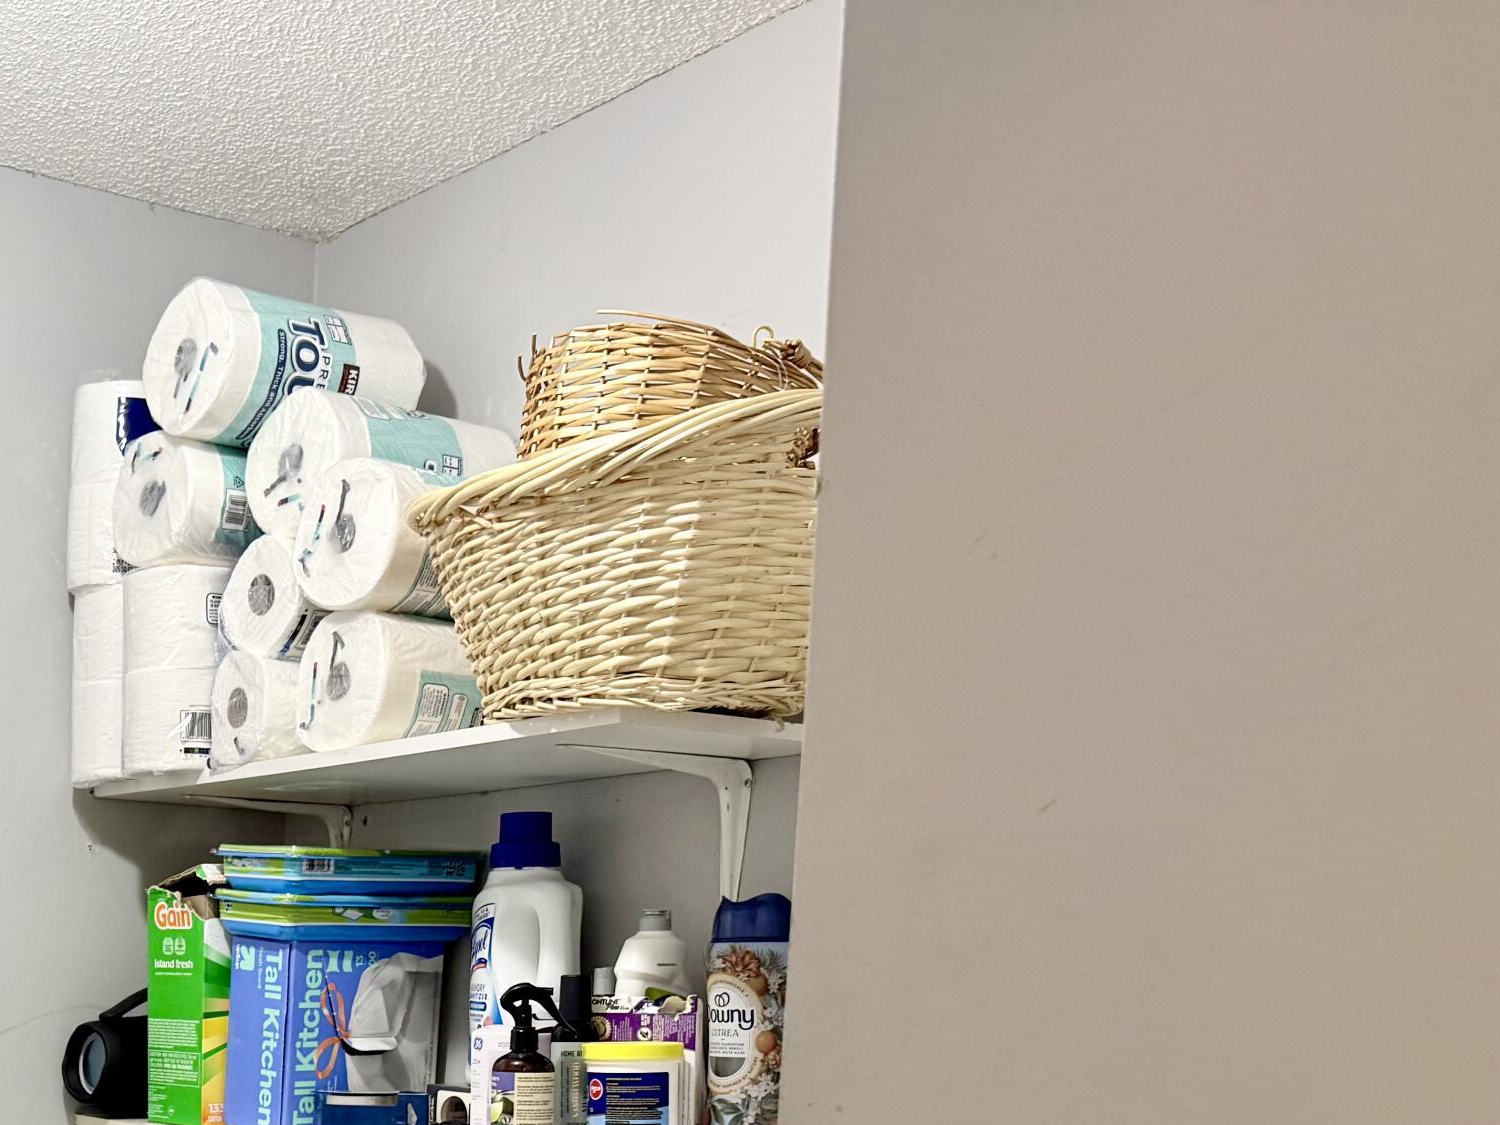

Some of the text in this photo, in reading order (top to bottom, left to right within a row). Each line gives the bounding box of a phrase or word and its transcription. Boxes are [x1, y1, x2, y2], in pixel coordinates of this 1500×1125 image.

[274, 366, 285, 389] Thick
[316, 355, 331, 389] PRE
[345, 369, 359, 395] KIR
[154, 900, 193, 930] Gain
[175, 958, 194, 969] fresh
[264, 949, 283, 1000] Tall
[295, 949, 323, 1072] Kitchen
